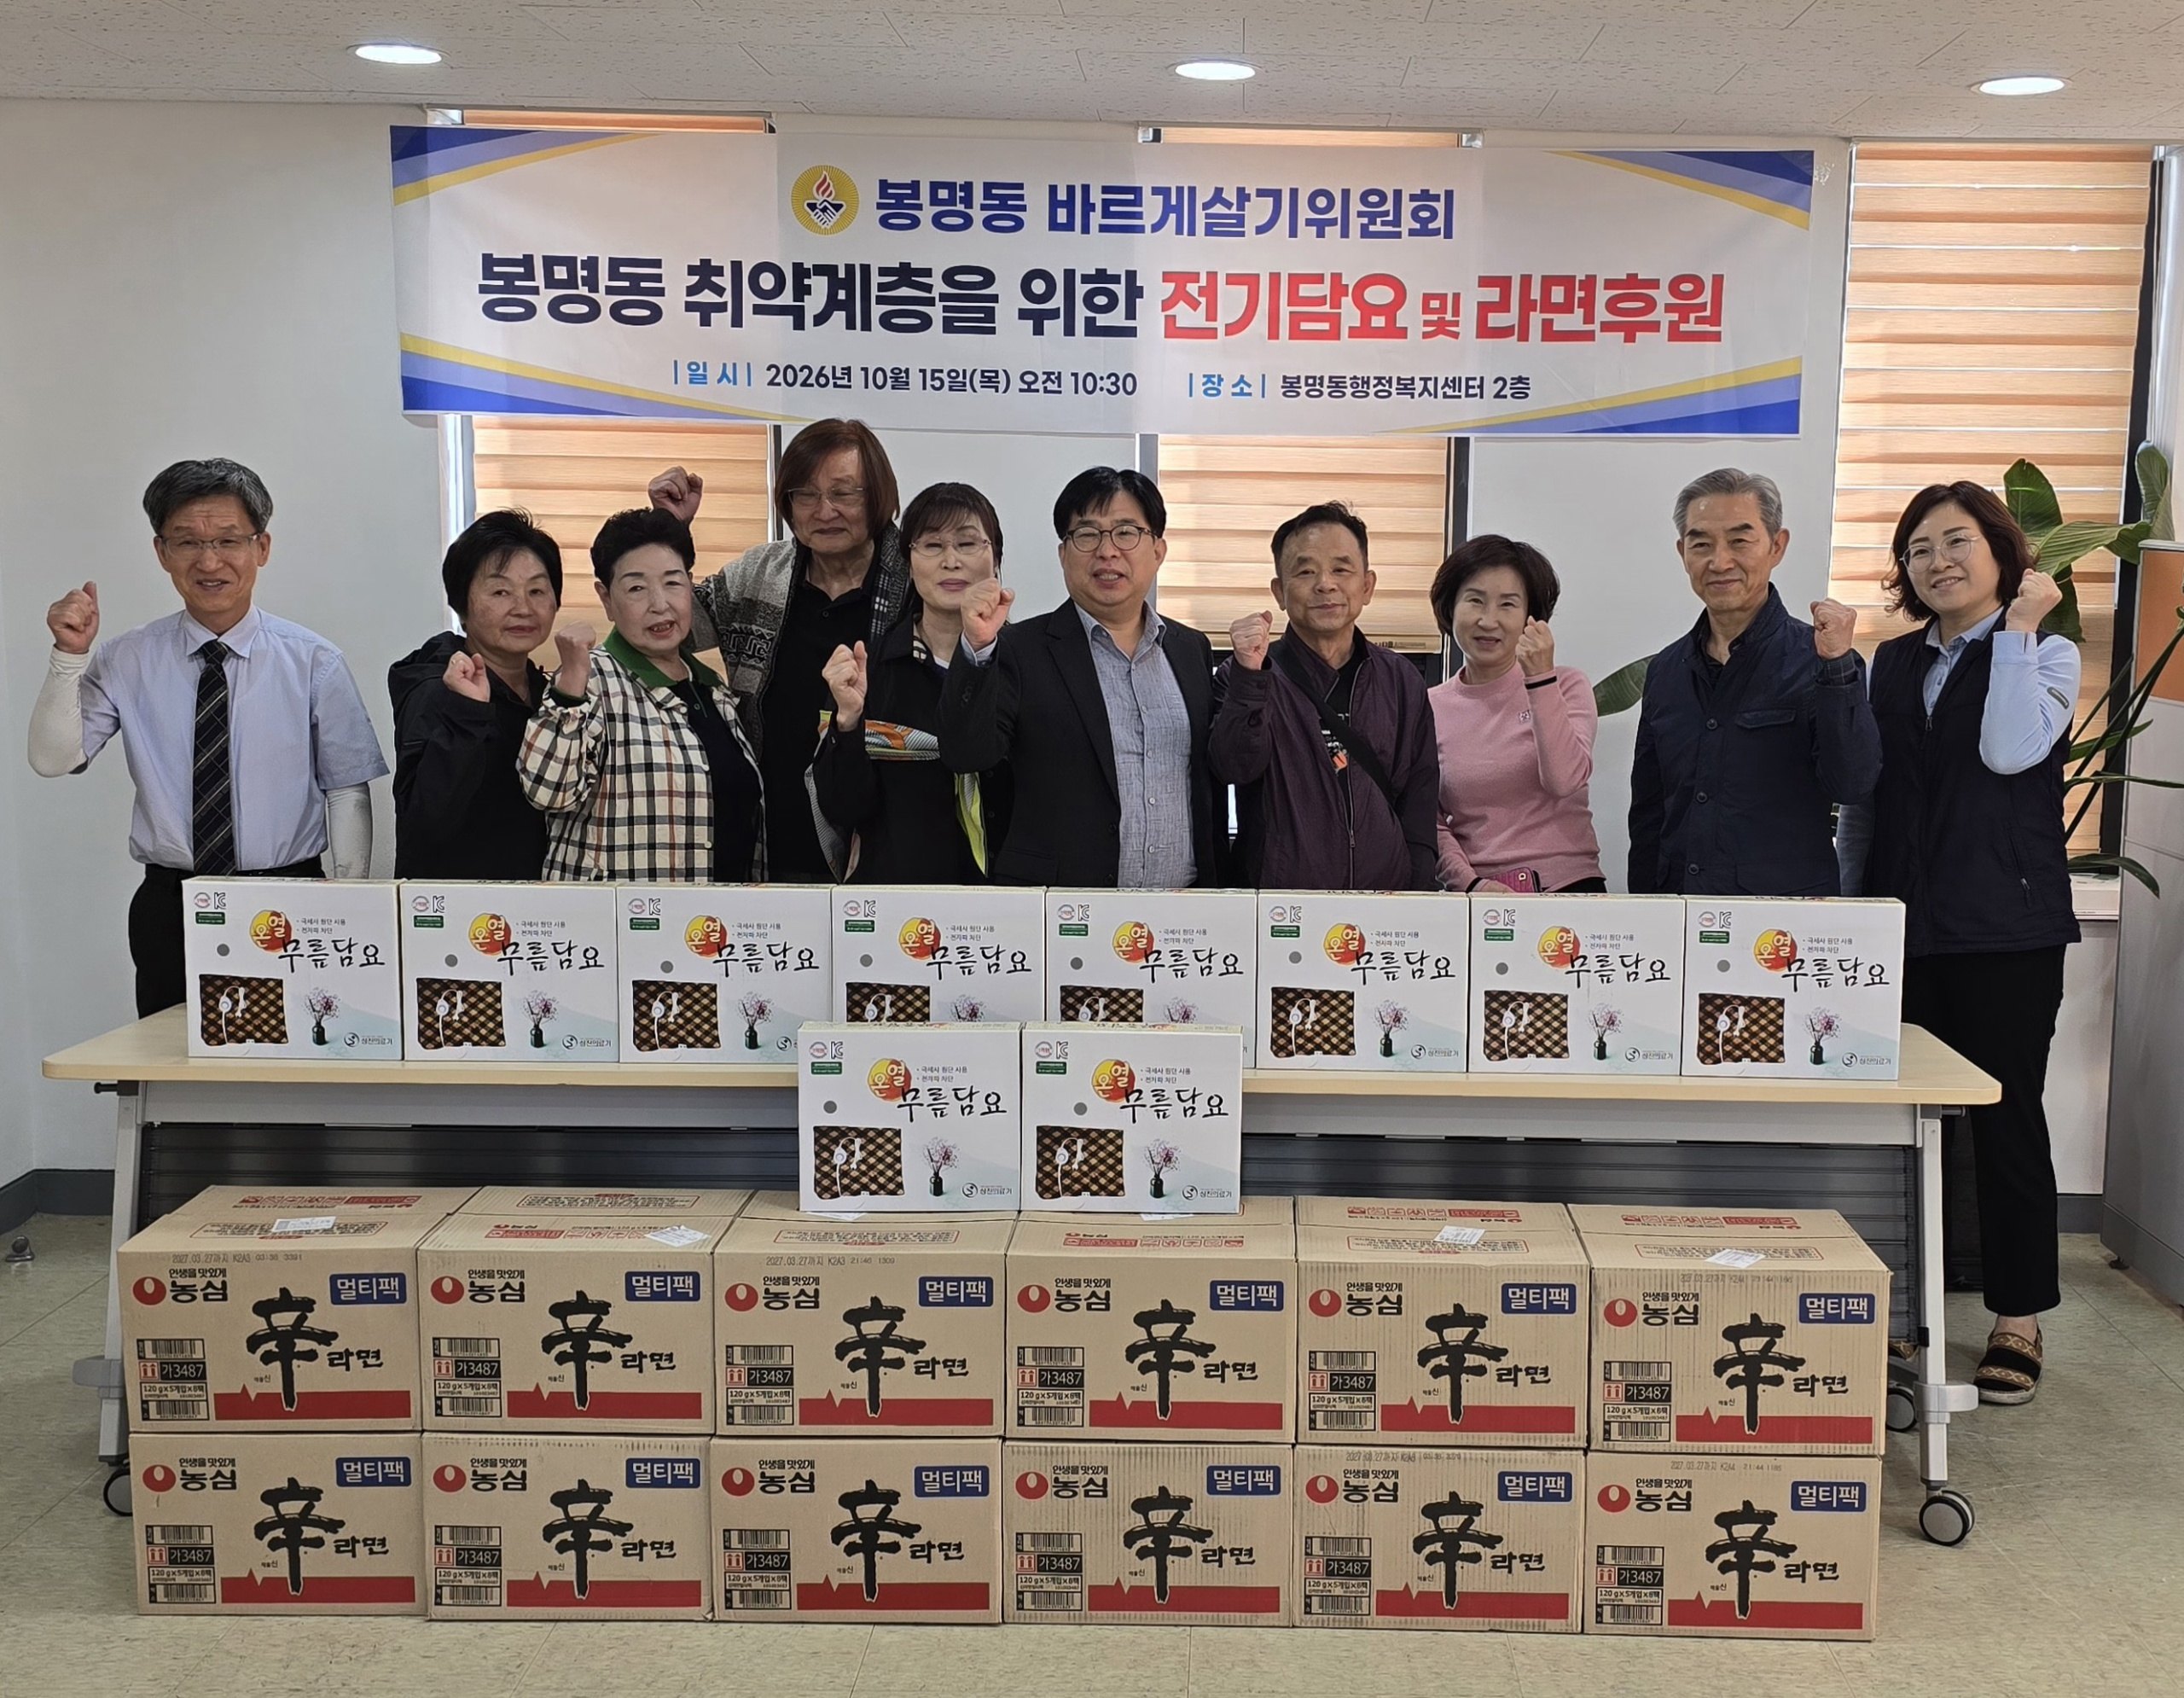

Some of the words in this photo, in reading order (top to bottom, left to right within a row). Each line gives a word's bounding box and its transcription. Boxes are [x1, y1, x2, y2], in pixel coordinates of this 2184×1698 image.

[876, 178, 1028, 232] 봉명동
[1048, 182, 1455, 240] 바르게살기위원회
[478, 253, 666, 327] 봉명동
[685, 258, 999, 336] 취약계층을
[1017, 266, 1144, 338] 위한
[1159, 270, 1409, 342] 전기담요
[1421, 292, 1461, 340] 및
[1476, 273, 1724, 344] 라면후원
[766, 363, 853, 390] 2026년
[861, 365, 911, 392] 10월
[918, 367, 1012, 395] 15일(목)
[1018, 369, 1063, 395] 오전
[1070, 371, 1137, 398] 10:30
[1280, 375, 1485, 400] 봉명동행정복지센터
[1493, 376, 1531, 399] 2층
[253, 912, 287, 948] 온열
[471, 916, 506, 951] 온열
[688, 918, 722, 951] 온열
[902, 920, 936, 953] 온열
[1115, 924, 1150, 958] 온열
[1327, 927, 1361, 960] 온열
[1540, 928, 1575, 963] 온열
[1757, 932, 1792, 967] 온열
[278, 938, 386, 973] 무릎담요
[497, 939, 605, 975] 무릎담요
[713, 941, 819, 977] 무릎담요
[926, 944, 1032, 980] 무릎담요
[1139, 947, 1244, 983] 무릎담요
[1351, 949, 1455, 985] 무릎담요
[1565, 952, 1671, 988] 무릎담요
[1781, 956, 1890, 991] 무릎담요
[871, 1061, 906, 1096] 온열
[1096, 1062, 1130, 1097] 온열
[897, 1085, 1008, 1122] 무릎담요
[1119, 1087, 1228, 1124] 무릎담요
[169, 1268, 196, 1278] 인생을
[198, 1268, 227, 1278] 맛있게
[468, 1269, 494, 1279] 인생을
[497, 1269, 525, 1278] 맛있게
[763, 1276, 790, 1286] 인생을
[792, 1276, 820, 1286] 맛있게
[1054, 1278, 1081, 1288] 인생을
[1083, 1278, 1111, 1288] 맛있게
[170, 1279, 229, 1304] 농심
[337, 1277, 399, 1300] 멀티팩
[468, 1281, 526, 1303] 농심
[632, 1276, 694, 1298] 멀티팩
[926, 1281, 986, 1303] 멀티팩
[1217, 1284, 1277, 1306] 멀티팩
[1346, 1282, 1373, 1292] 인생을
[1375, 1282, 1403, 1292] 맛있게
[1642, 1292, 1670, 1301] 인생을
[1671, 1292, 1699, 1301] 맛있게
[763, 1288, 820, 1311] 농심
[1054, 1290, 1111, 1312] 농심
[1346, 1294, 1403, 1317] 농심
[1508, 1288, 1569, 1310] 멀티팩
[1806, 1297, 1867, 1319] 멀티팩
[1642, 1304, 1699, 1326] 농심
[247, 1287, 339, 1411] 辛
[327, 1349, 383, 1371] 라면
[542, 1290, 633, 1410] 辛
[835, 1296, 926, 1417] 辛
[1125, 1300, 1216, 1420] 辛
[162, 1364, 204, 1377] 가3487
[457, 1362, 498, 1375] 가3487
[621, 1351, 676, 1373] 라면
[914, 1358, 968, 1380] 라면
[1204, 1361, 1258, 1383] 라면
[1418, 1303, 1508, 1425] 辛
[749, 1369, 791, 1384] 가3487
[1041, 1371, 1081, 1384] 가3487
[1332, 1375, 1374, 1389] 가3487
[1496, 1365, 1551, 1387] 라면
[1713, 1313, 1805, 1434] 辛
[1627, 1387, 1669, 1400] 가3487
[1793, 1375, 1849, 1397] 라면
[179, 1458, 206, 1467] 인생을
[208, 1458, 235, 1468] 맛있게
[343, 1461, 404, 1483] 멀티팩
[470, 1458, 497, 1468] 인생을
[499, 1458, 526, 1468] 맛있게
[633, 1462, 694, 1484] 멀티팩
[758, 1460, 785, 1469] 인생을
[787, 1460, 815, 1469] 맛있게
[1053, 1466, 1079, 1474] 인생을
[1081, 1466, 1108, 1474] 맛있게
[1343, 1469, 1369, 1479] 인생을
[1371, 1469, 1398, 1479] 맛있게
[180, 1468, 237, 1491] 농심
[470, 1469, 527, 1492] 농심
[758, 1471, 815, 1493] 농심
[922, 1470, 982, 1492] 멀티팩
[1052, 1476, 1108, 1498] 농심
[1213, 1469, 1274, 1491] 멀티팩
[1505, 1476, 1565, 1497] 멀티팩
[1635, 1479, 1663, 1488] 인생을
[1664, 1479, 1692, 1488] 맛있게
[1343, 1481, 1398, 1503] 농심
[1635, 1490, 1692, 1512] 농심
[1798, 1486, 1859, 1507] 멀티팩
[254, 1477, 346, 1596] 辛
[334, 1536, 389, 1558] 라면
[543, 1479, 633, 1600] 辛
[831, 1480, 921, 1602] 辛
[1124, 1486, 1213, 1604] 辛
[171, 1550, 212, 1562] 가3487
[457, 1550, 499, 1564] 가3487
[621, 1539, 677, 1561] 라면
[747, 1554, 787, 1567] 가3487
[909, 1541, 964, 1563] 라면
[1201, 1546, 1255, 1567] 라면
[1413, 1491, 1503, 1609] 辛
[1705, 1500, 1798, 1619] 辛
[1039, 1556, 1080, 1570] 가3487
[1327, 1560, 1368, 1574] 가3487
[1490, 1552, 1545, 1573] 라면
[1784, 1561, 1839, 1583] 라면
[1619, 1570, 1661, 1584] 가3487
